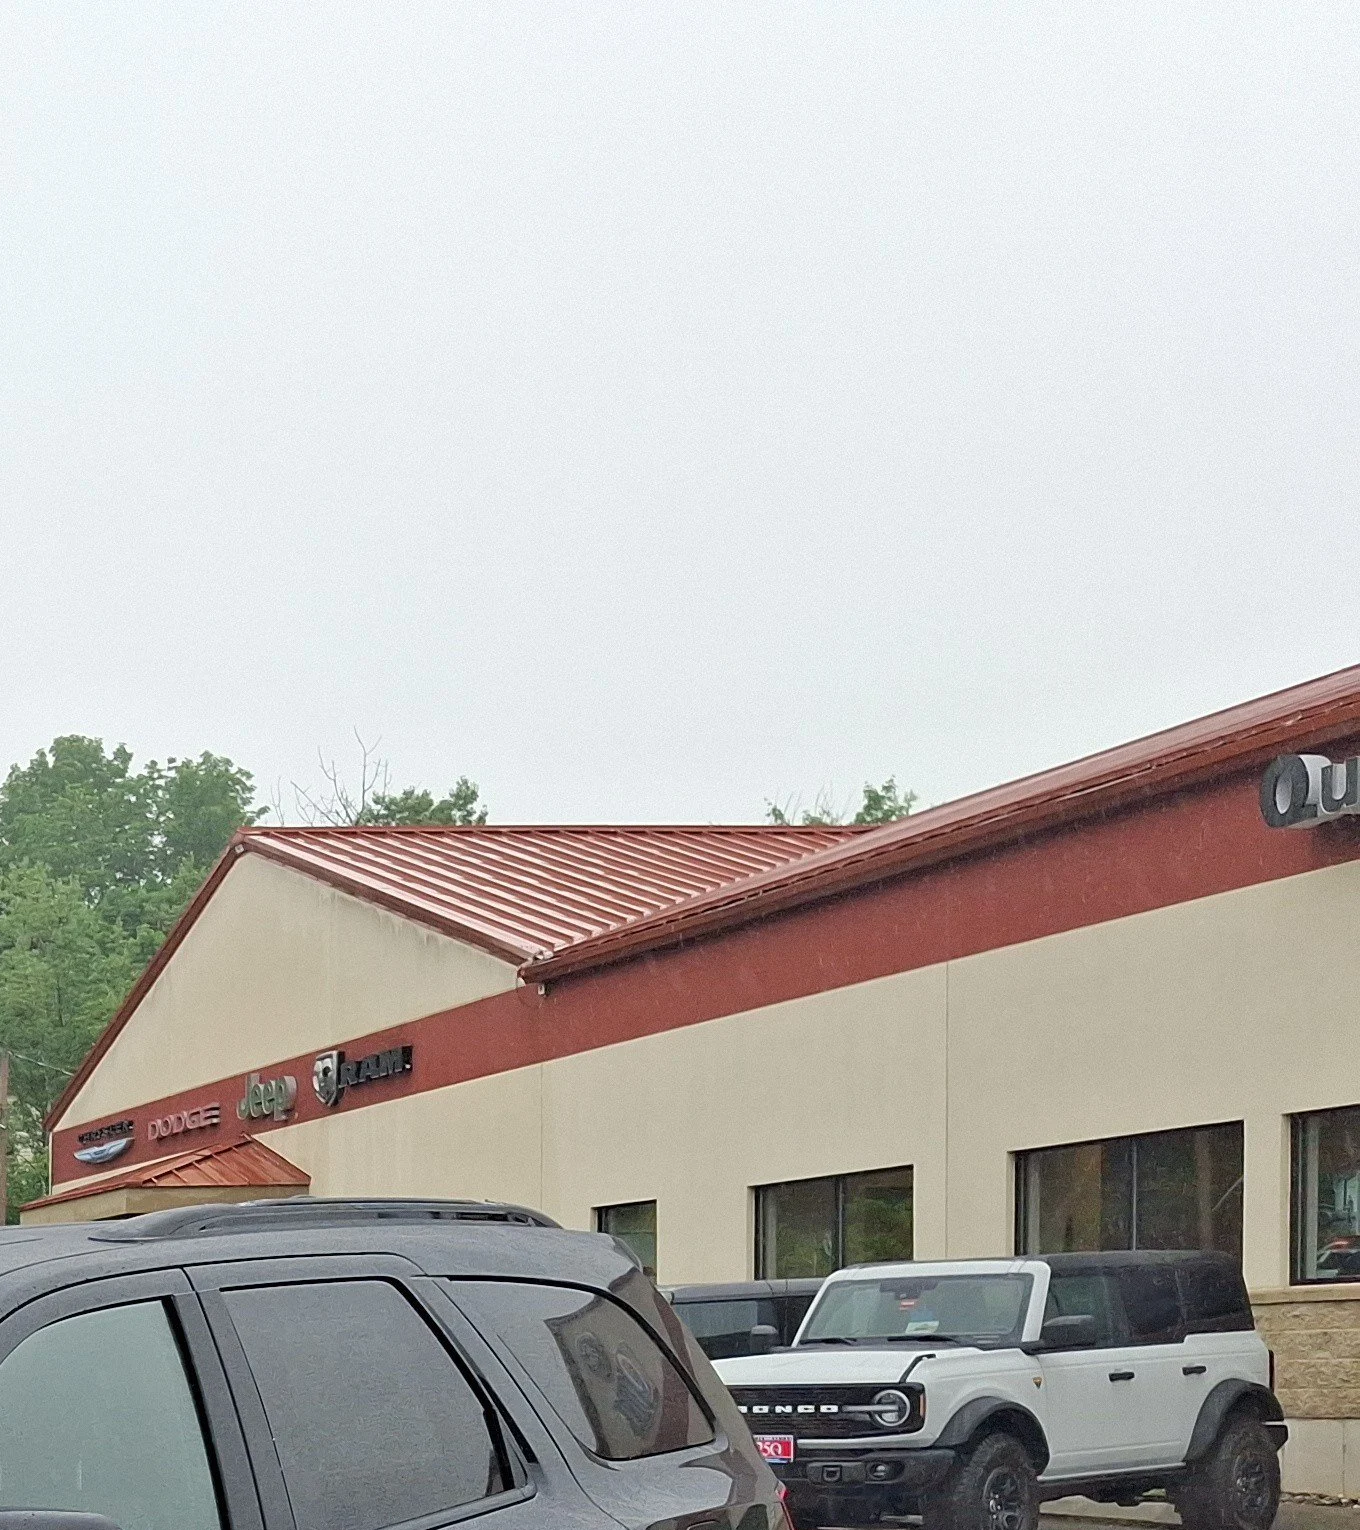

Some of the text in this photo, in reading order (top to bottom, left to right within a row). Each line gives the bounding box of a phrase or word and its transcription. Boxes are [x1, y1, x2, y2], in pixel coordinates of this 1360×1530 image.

[339, 1045, 413, 1090] RAM
[236, 1072, 299, 1122] Jeep
[147, 1101, 221, 1141] DODGE
